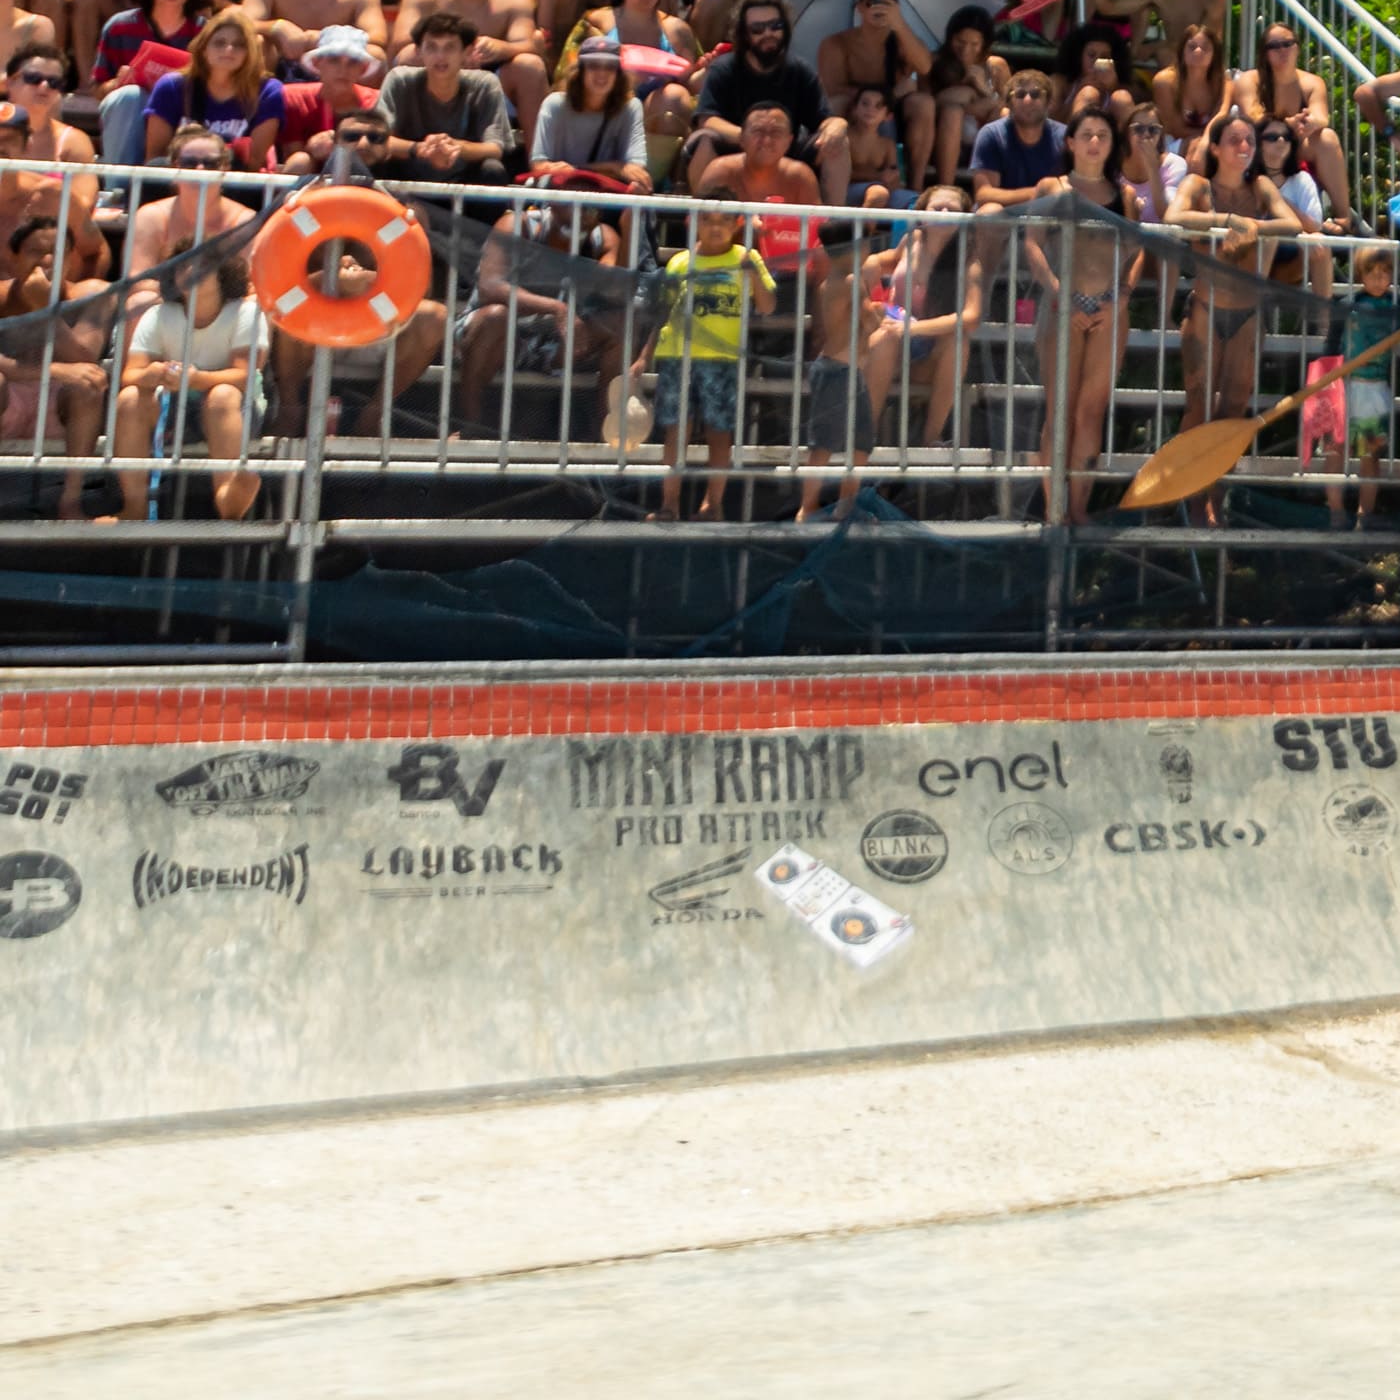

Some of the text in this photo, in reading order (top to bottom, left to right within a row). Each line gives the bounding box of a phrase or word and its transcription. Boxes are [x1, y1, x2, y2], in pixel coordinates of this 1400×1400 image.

[1273, 715, 1398, 771] STU
[4, 761, 88, 799] POS
[567, 733, 864, 808] MINI RAMP
[918, 740, 1069, 797] enel
[615, 808, 827, 847] PRO ATTACK
[359, 842, 564, 879] LAYBACK
[865, 836, 933, 858] BLANK
[133, 843, 310, 909] INDEPENDENT
[440, 886, 486, 897] BEER
[650, 906, 765, 927] HONDA
